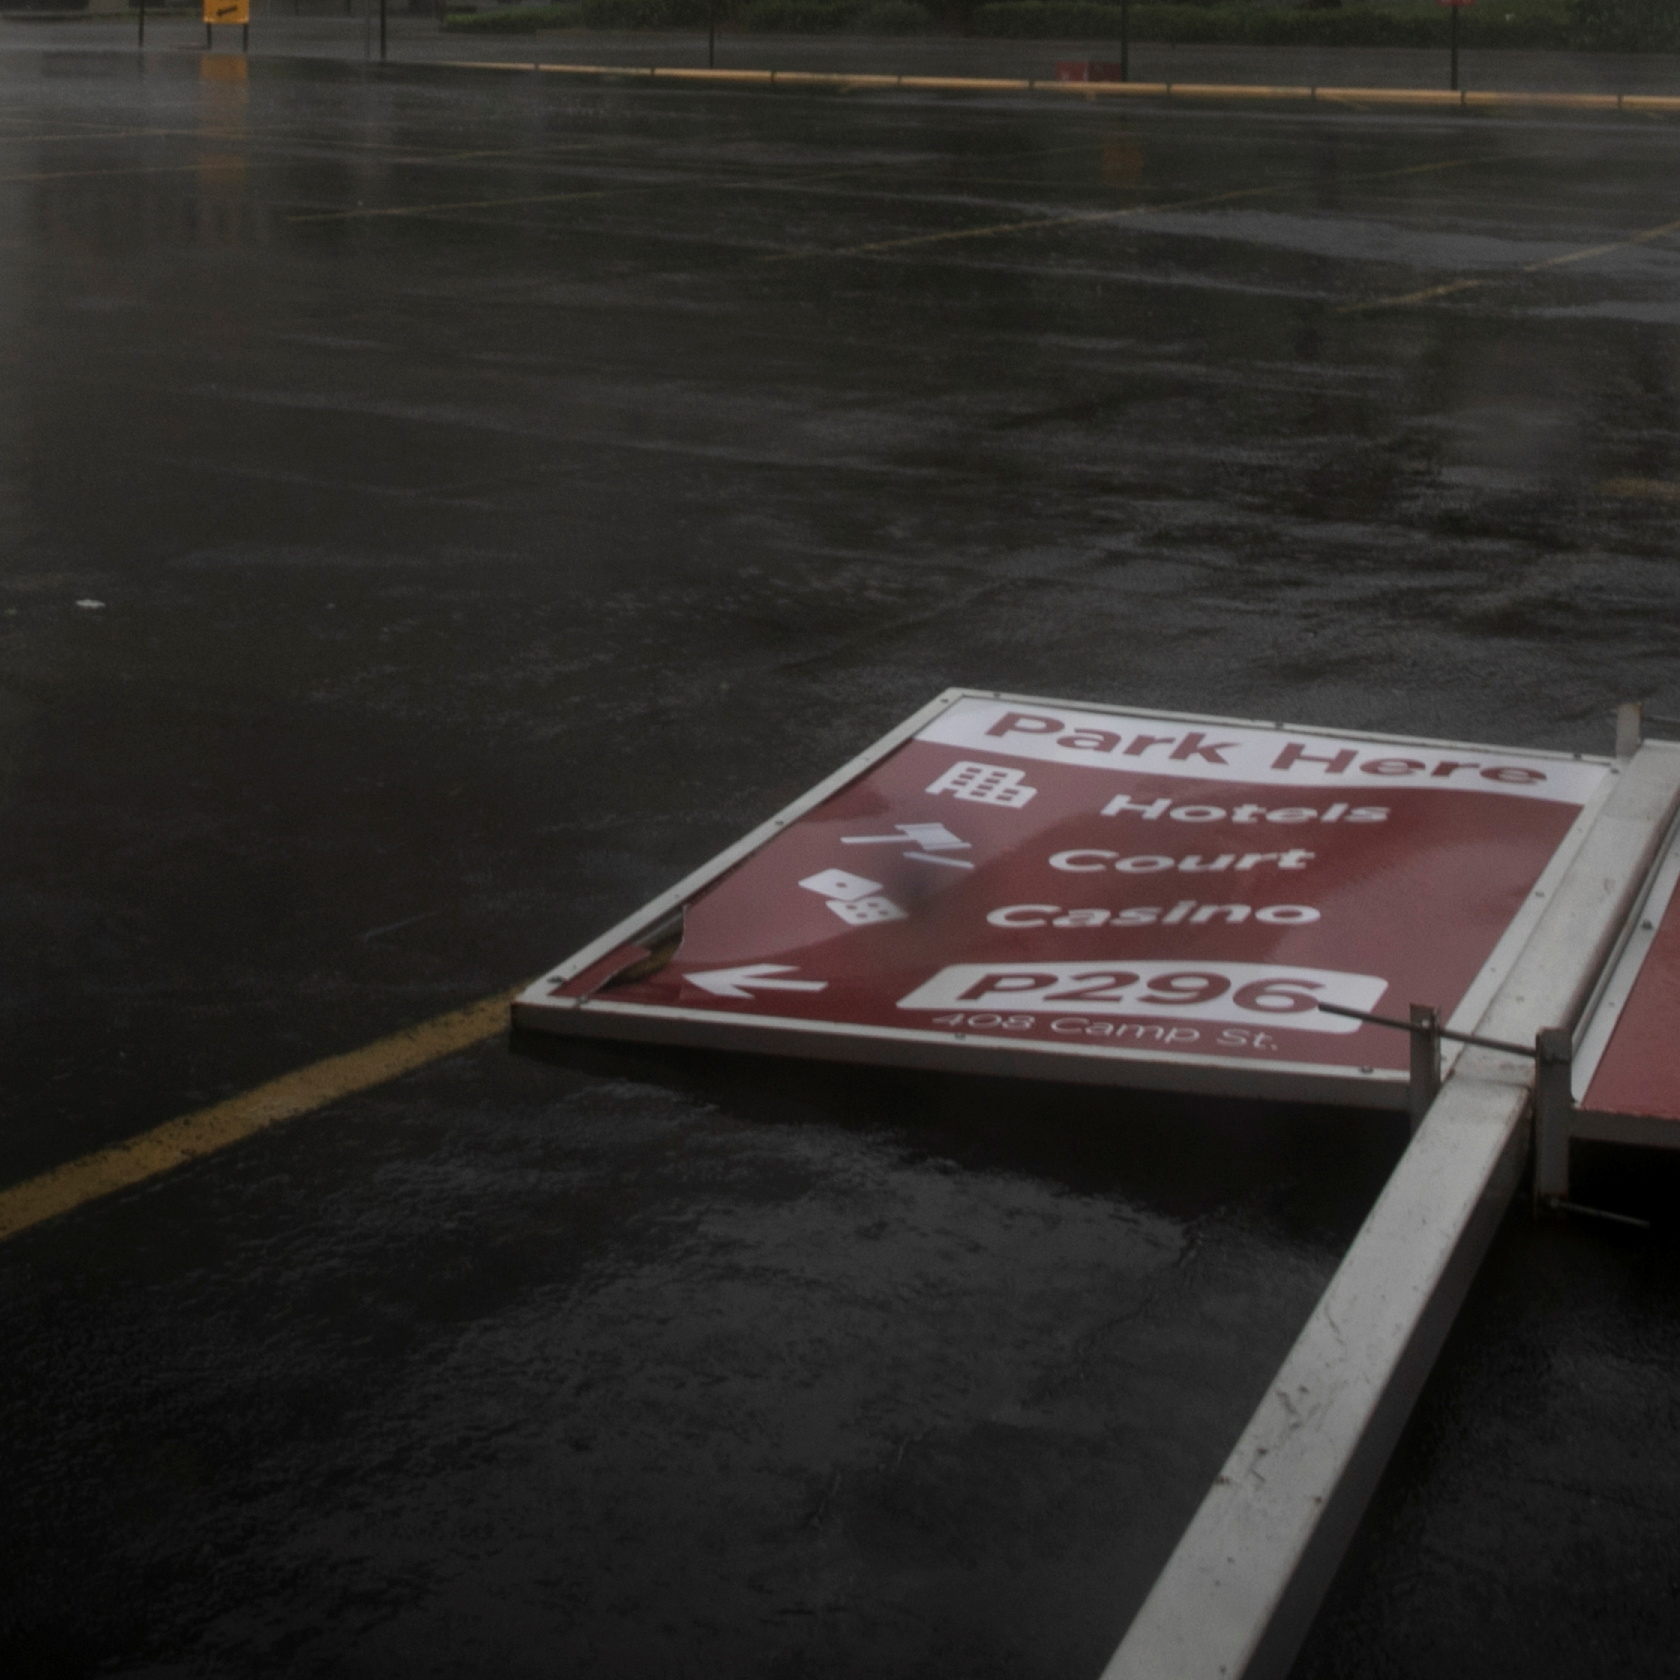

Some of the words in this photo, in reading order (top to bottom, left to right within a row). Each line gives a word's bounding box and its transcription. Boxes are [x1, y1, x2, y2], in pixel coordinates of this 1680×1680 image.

[984, 713, 1245, 766] Park
[1270, 742, 1548, 785] Here
[1100, 794, 1392, 823] Hotels
[1048, 848, 1316, 874] Court
[986, 899, 1321, 928] Casino
[956, 971, 1326, 1014] P296
[932, 1011, 1037, 1031] 408
[1050, 1017, 1200, 1045] Camp
[1216, 1027, 1279, 1052] St.
